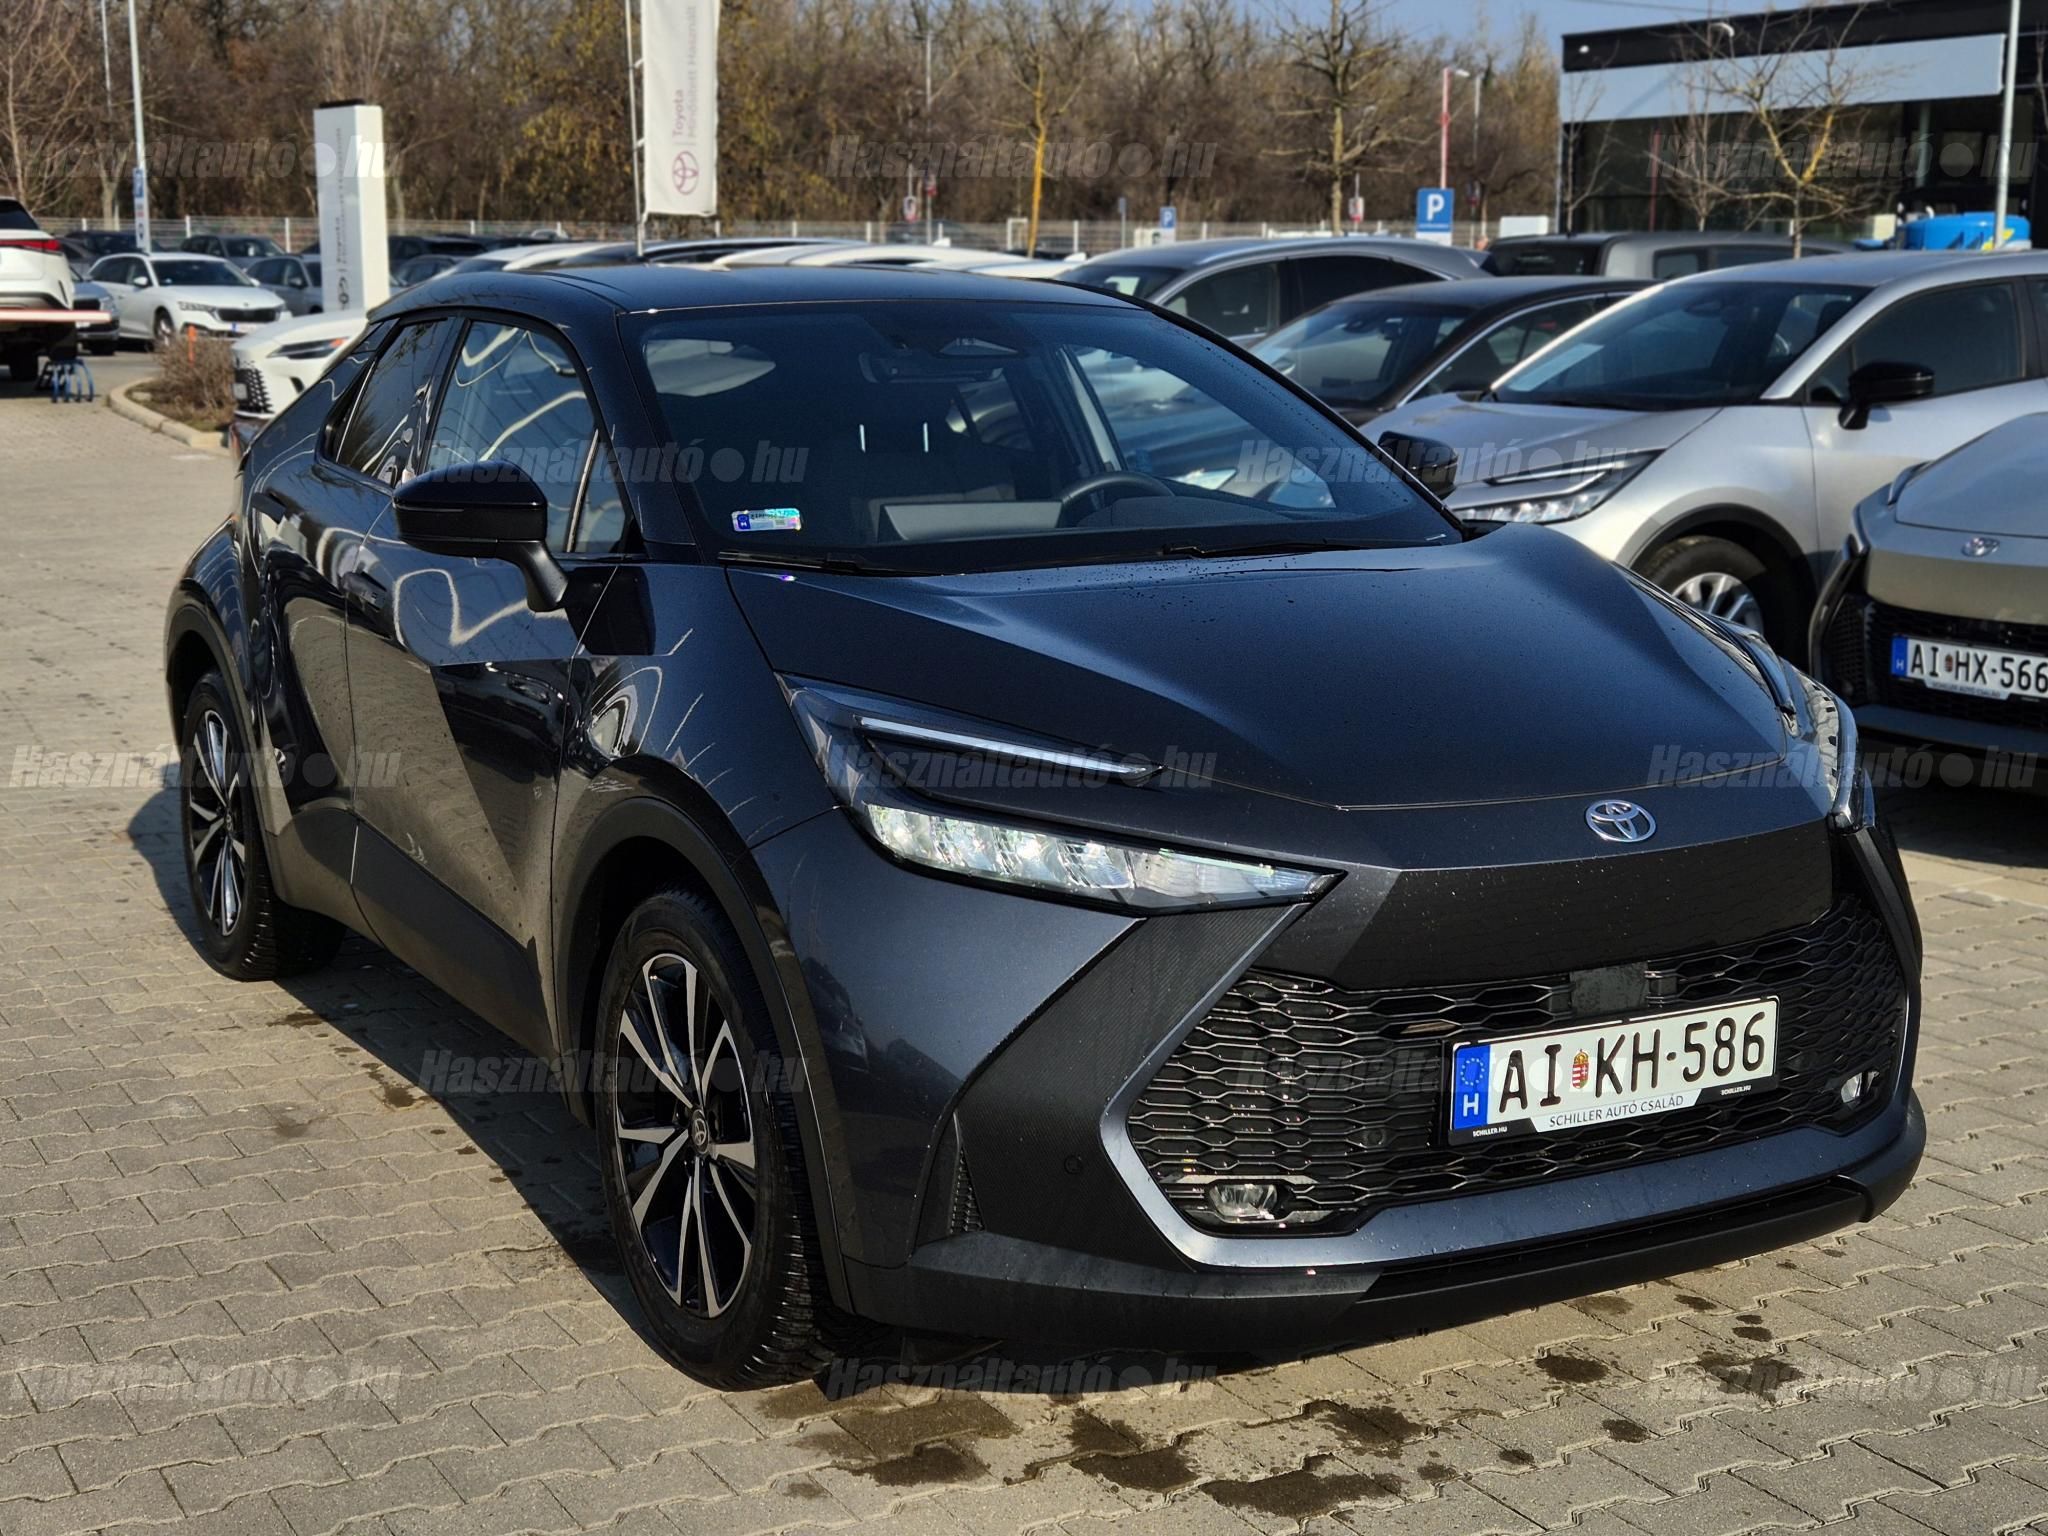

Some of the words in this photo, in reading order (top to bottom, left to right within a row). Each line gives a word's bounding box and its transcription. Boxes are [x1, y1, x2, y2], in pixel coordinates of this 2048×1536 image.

[672, 89, 685, 137] Toyota
[1427, 193, 1445, 221] P
[1896, 659, 1904, 670] H
[1911, 644, 1939, 677] AI
[1499, 1044, 1562, 1113] AI
[1594, 1011, 1765, 1098] KH-586
[1720, 1085, 1751, 1096] SCHILLER.HU
[1463, 1093, 1479, 1117] H
[1549, 1108, 1603, 1128] SCHILLER
[1605, 1099, 1637, 1119] AUTÓ
[1640, 1094, 1684, 1112] CSALÁD
[1472, 1125, 1508, 1137] SCHILLER.HU
